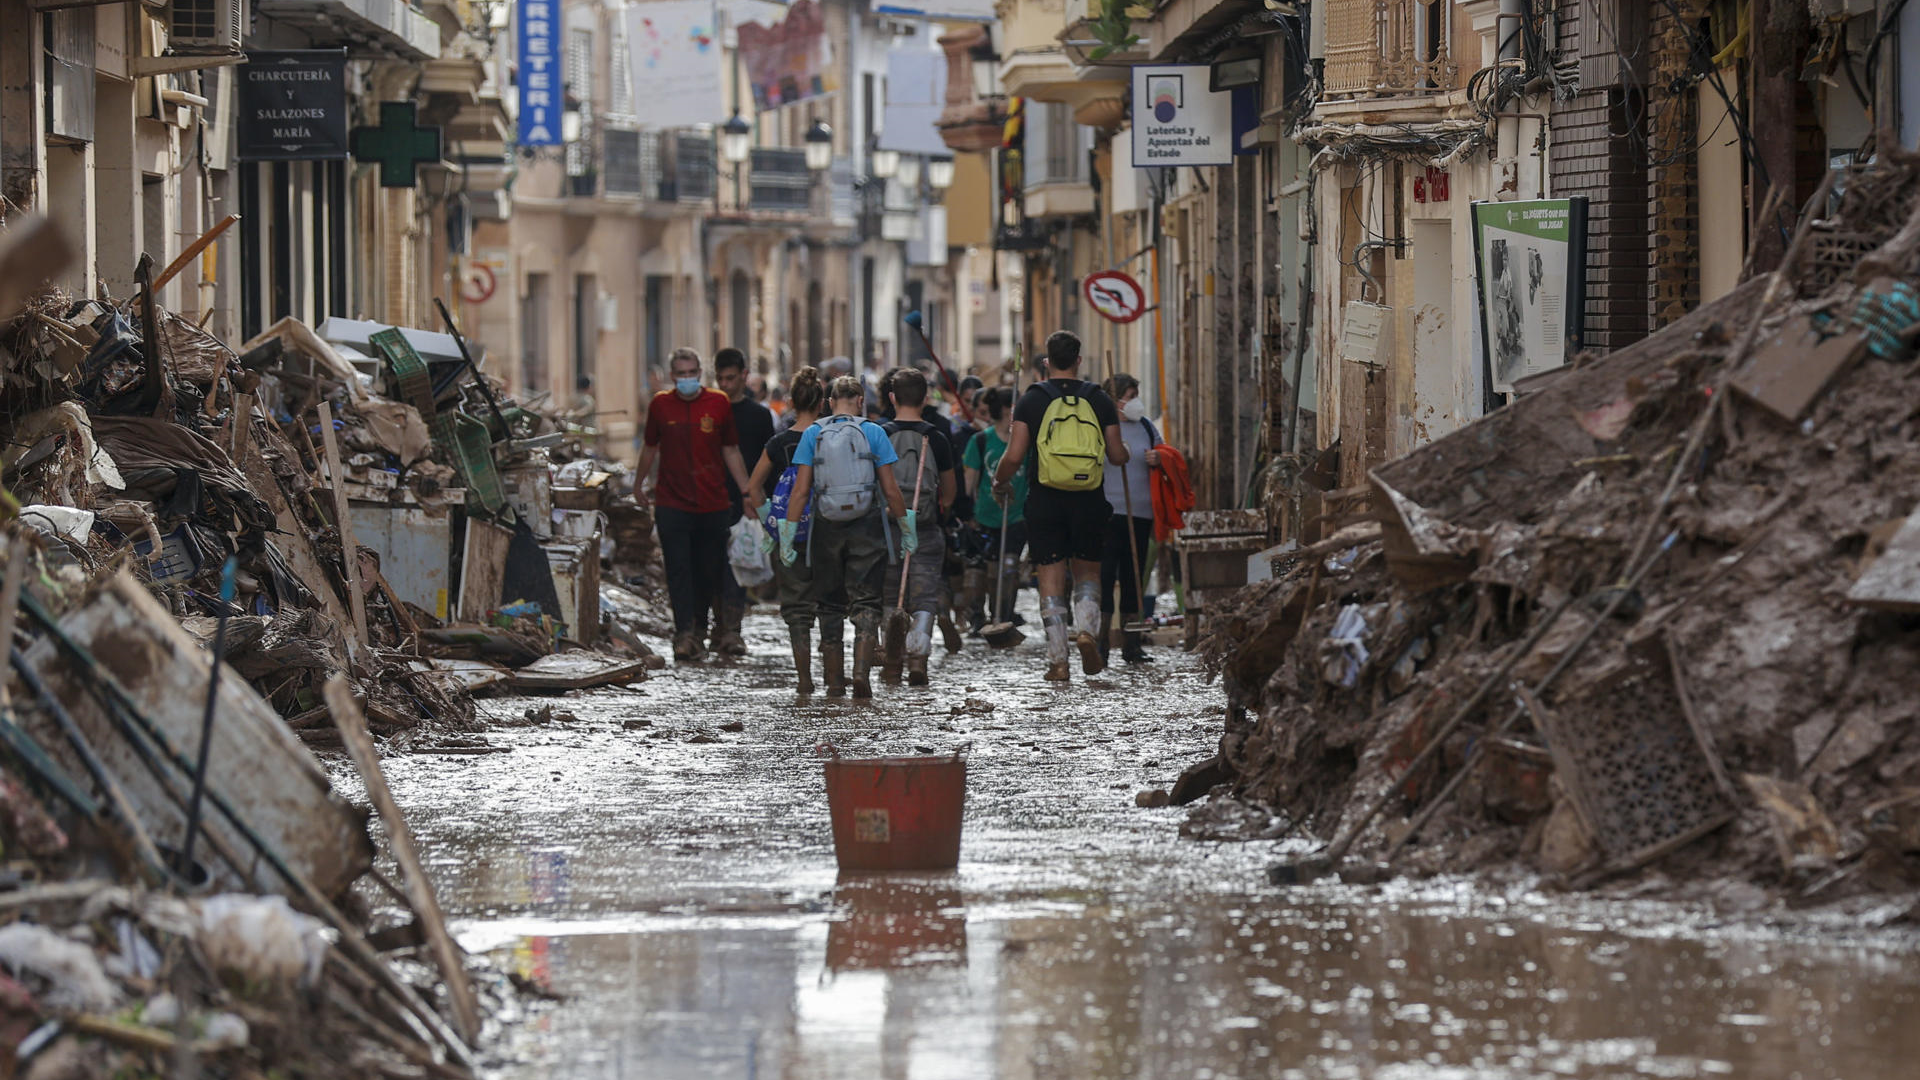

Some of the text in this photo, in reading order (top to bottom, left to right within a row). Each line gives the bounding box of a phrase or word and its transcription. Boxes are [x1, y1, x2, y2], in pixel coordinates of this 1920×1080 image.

[249, 68, 331, 81] CHARCUTERÍA
[524, 0, 553, 142] RRETERIA
[286, 90, 295, 99] Y
[257, 108, 325, 119] SALAZONES
[273, 125, 311, 138] MARÍA
[1189, 127, 1195, 137] y
[1148, 136, 1211, 148] Apuestas del
[1147, 148, 1181, 158] Estado
